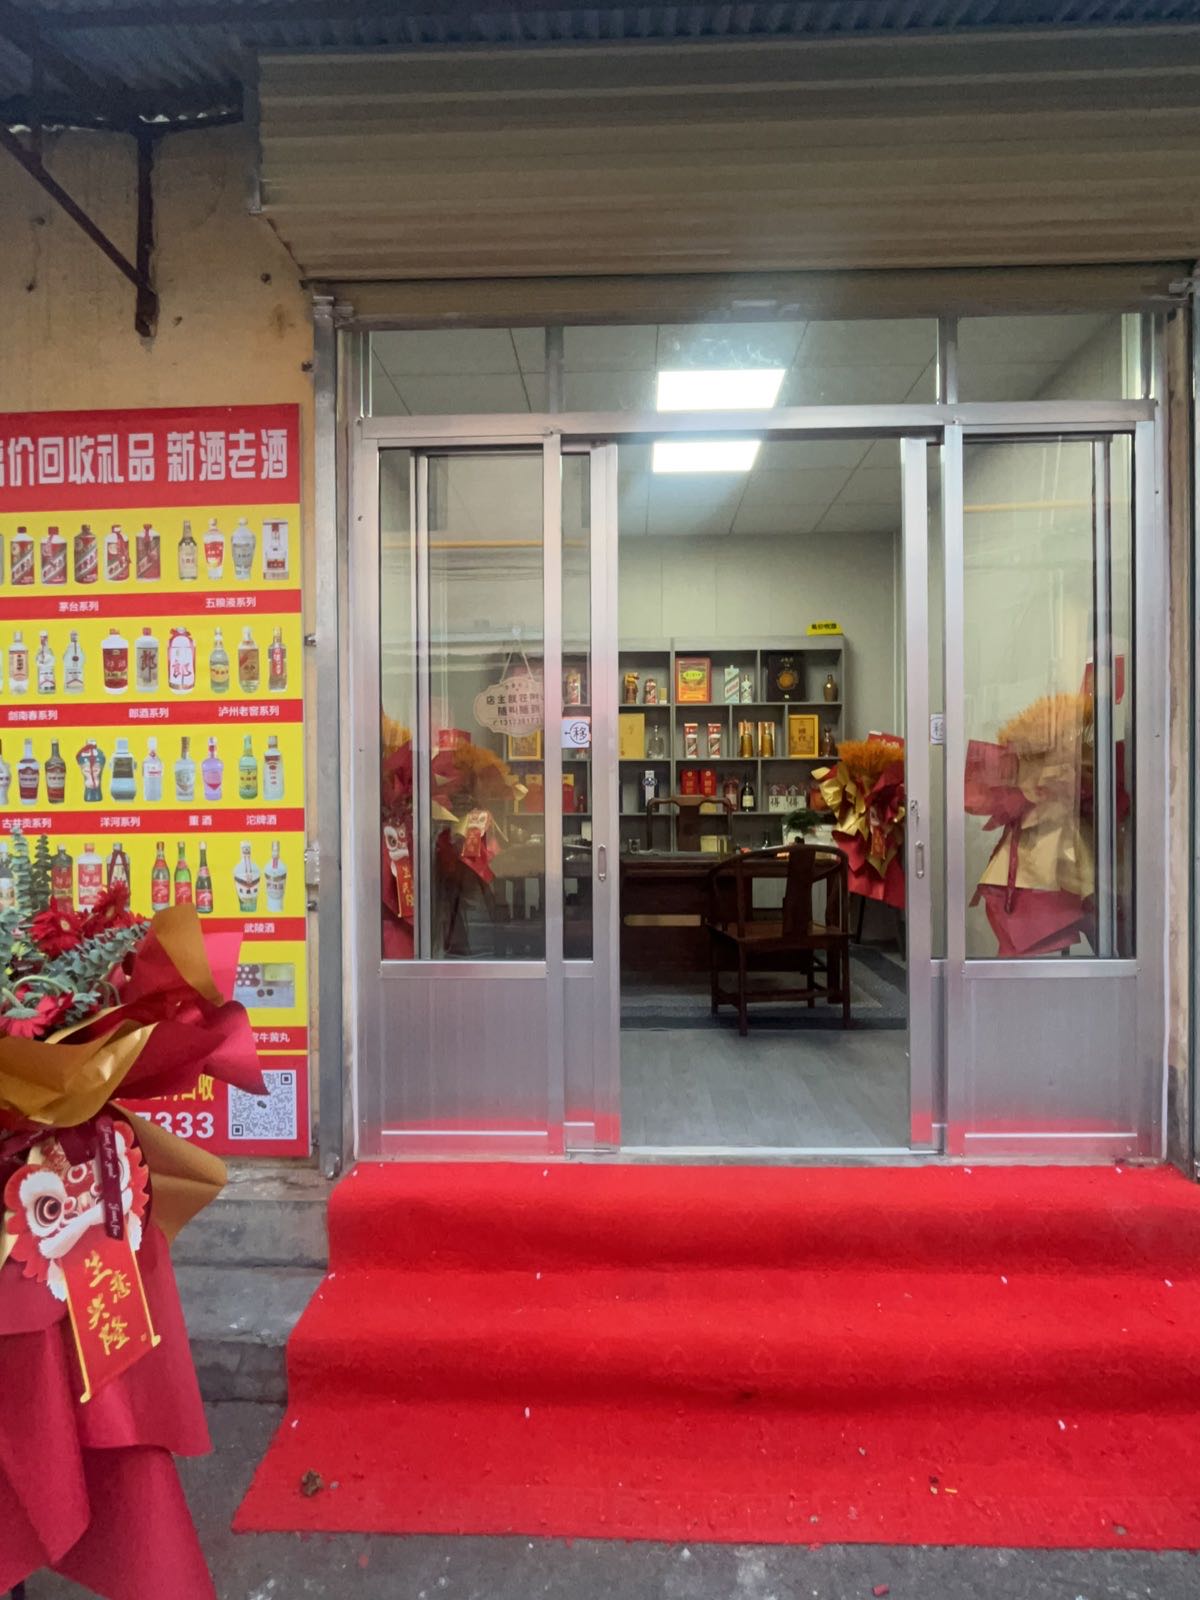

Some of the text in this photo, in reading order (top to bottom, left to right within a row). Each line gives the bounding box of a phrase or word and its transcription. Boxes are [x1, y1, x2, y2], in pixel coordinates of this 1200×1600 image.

[0, 429, 288, 487] 价回收礼品 新酒老酒
[58, 601, 99, 612] 茅台系列
[205, 596, 256, 608] 五粮液系列
[218, 705, 280, 717] 泸州老窖系列
[100, 816, 141, 827] 洋河系列
[246, 814, 277, 826] 沱牌酒
